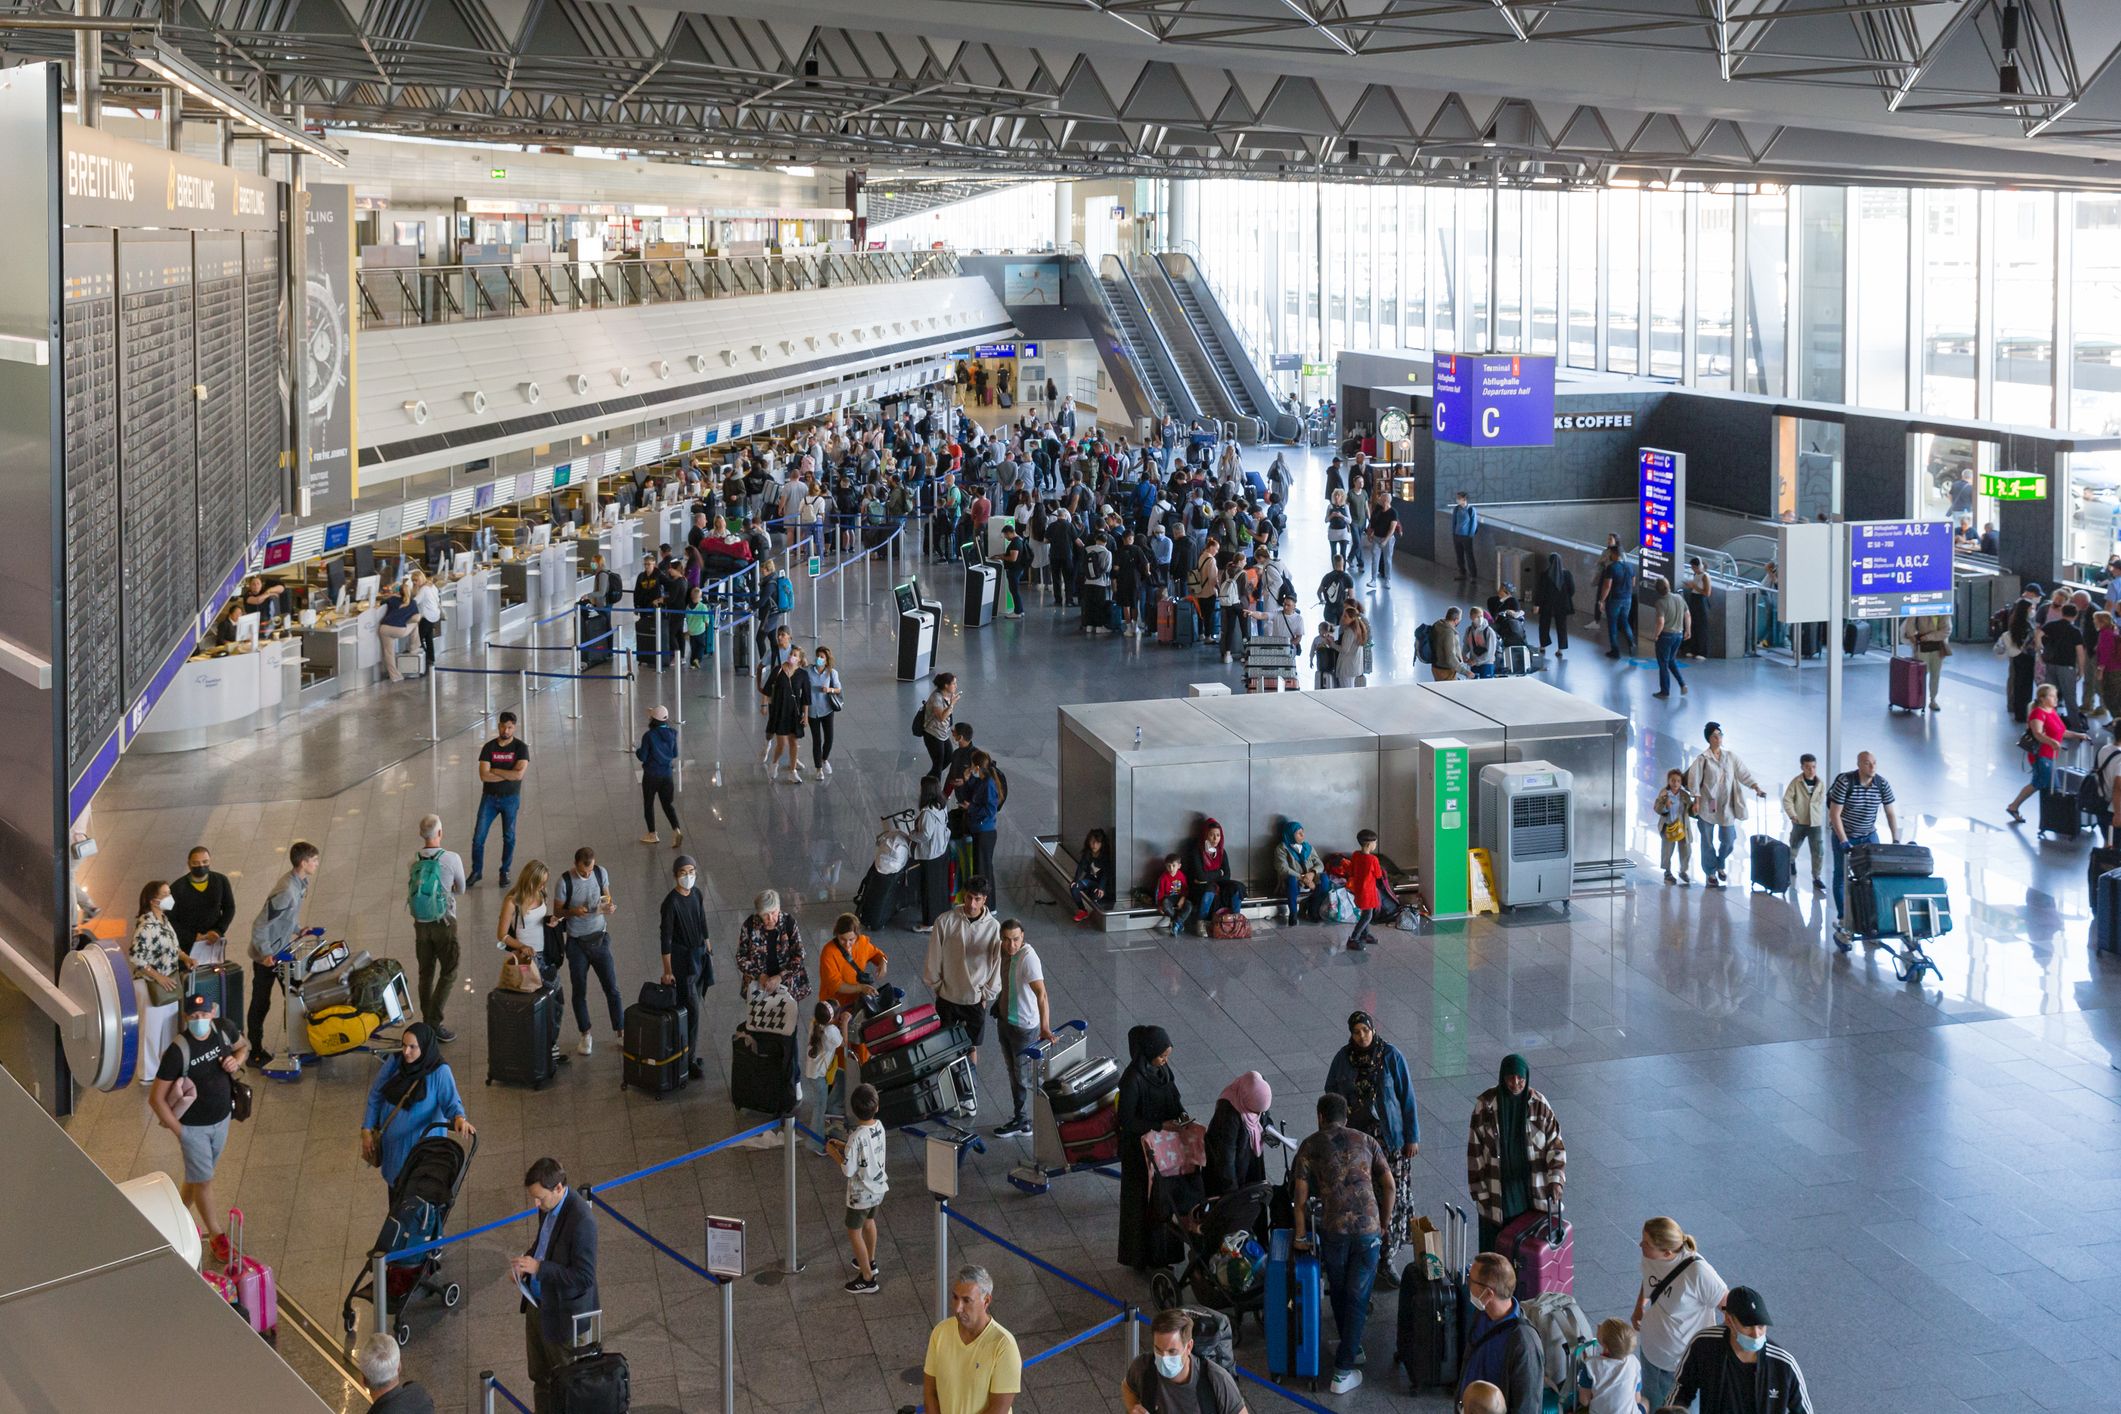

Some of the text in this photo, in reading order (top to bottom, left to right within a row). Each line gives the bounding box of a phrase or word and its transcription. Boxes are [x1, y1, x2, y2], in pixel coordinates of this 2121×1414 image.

[68, 151, 135, 201] BREITLING
[177, 174, 215, 210] BREITLING
[239, 186, 265, 215] BREITLING
[1483, 363, 1511, 372] Terminal
[1482, 377, 1520, 387] Abflughalle
[1482, 387, 1531, 396] Departures hall
[1436, 402, 1446, 432] C
[1481, 407, 1500, 438] C
[1575, 415, 1632, 428] COFFEE
[1664, 455, 1670, 468] C
